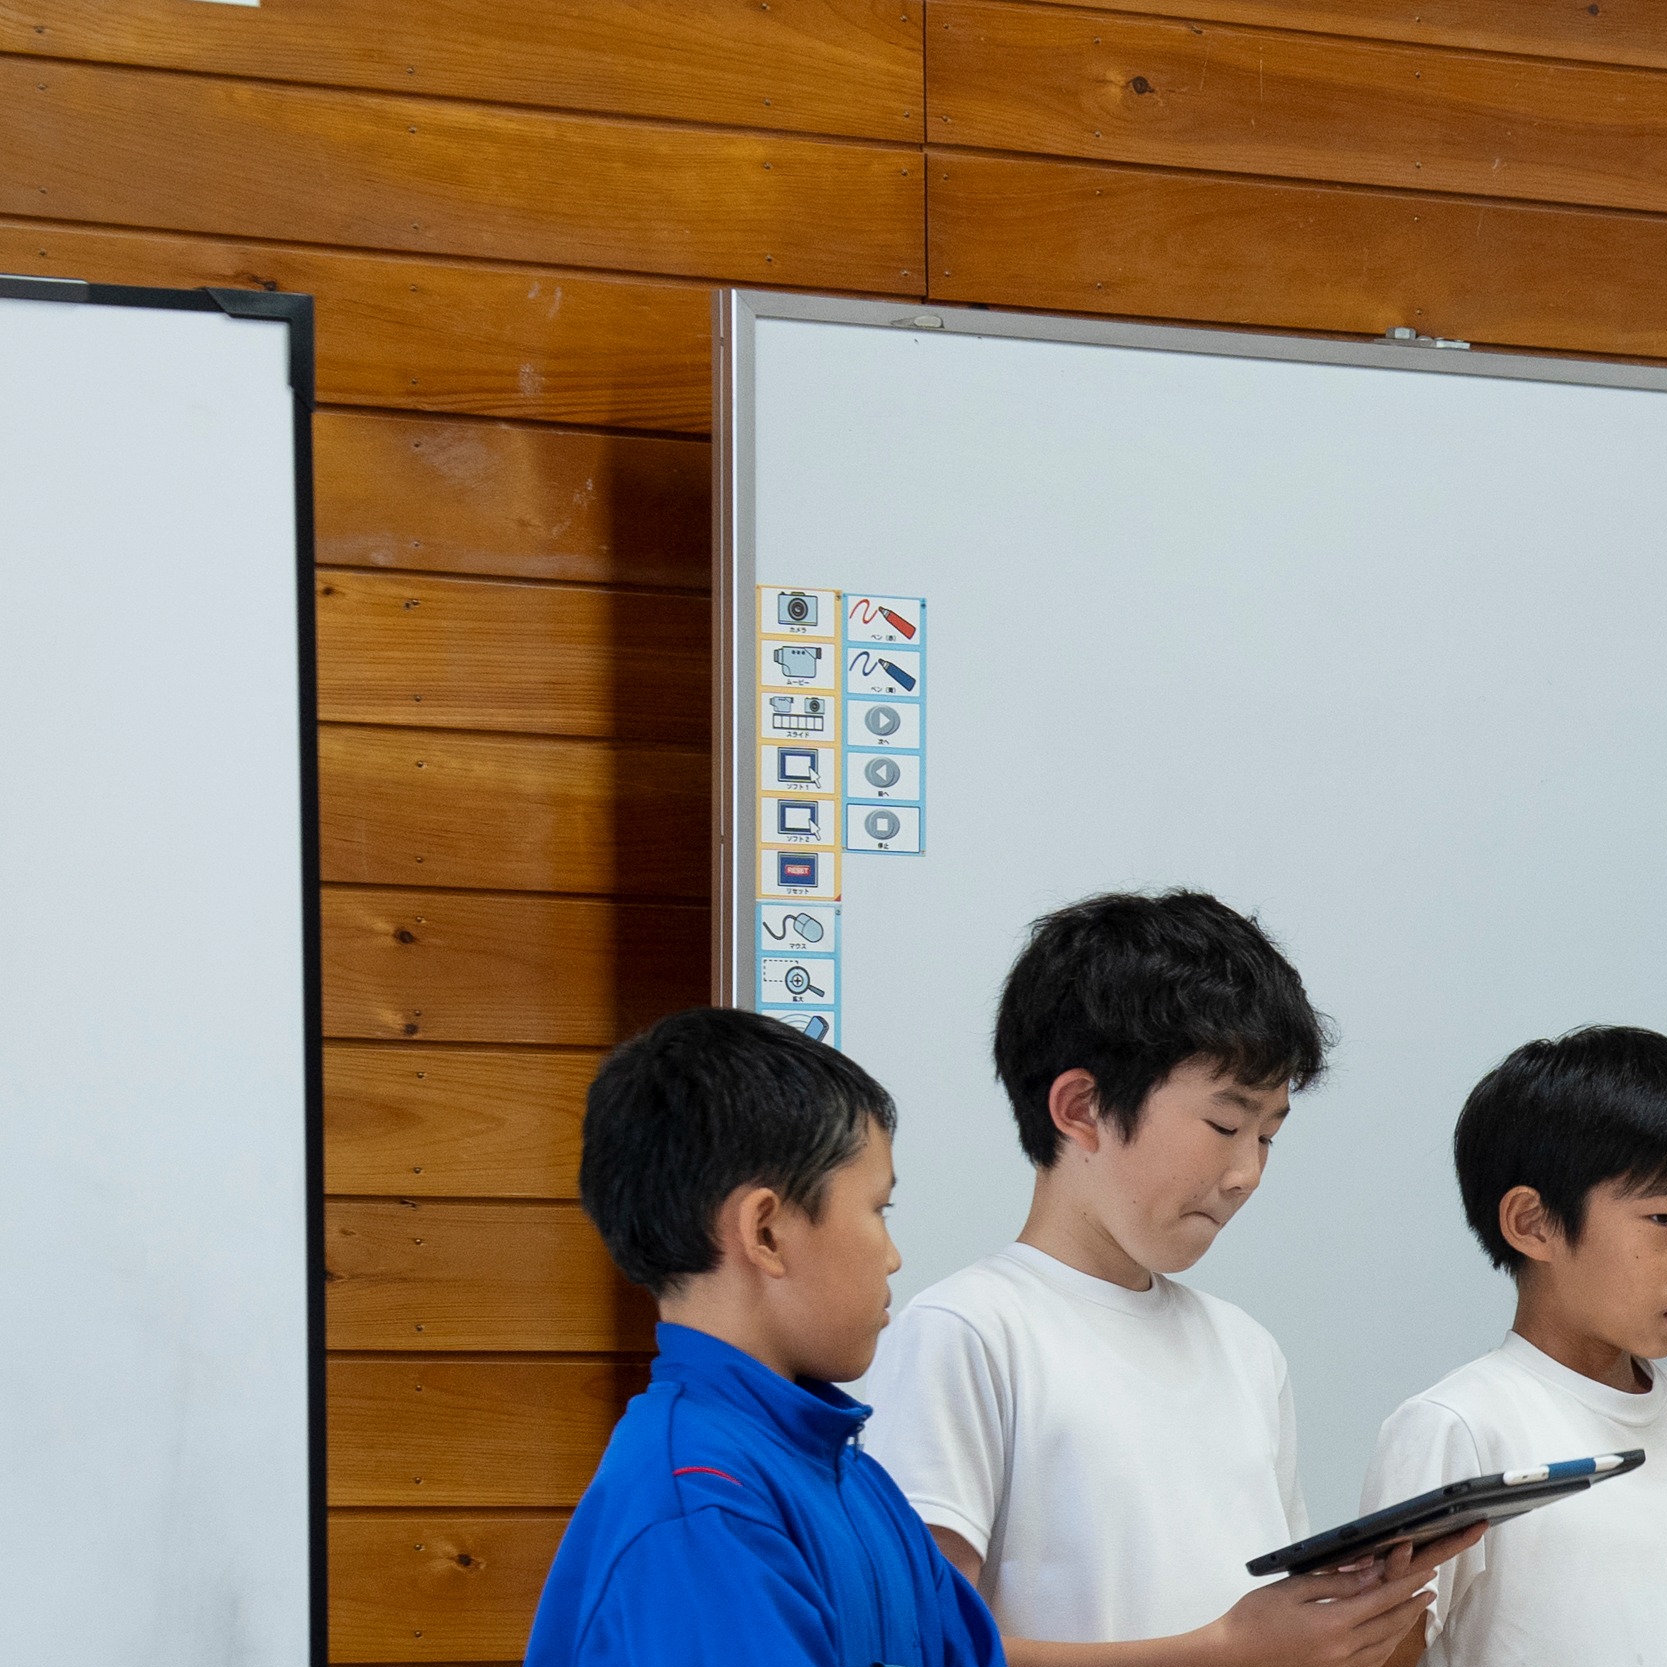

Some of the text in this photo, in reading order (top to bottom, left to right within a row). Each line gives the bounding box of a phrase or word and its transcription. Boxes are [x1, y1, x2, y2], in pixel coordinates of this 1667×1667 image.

[788, 626, 808, 634] カメラ
[786, 678, 810, 686] ムービー
[786, 887, 810, 895] リセット
